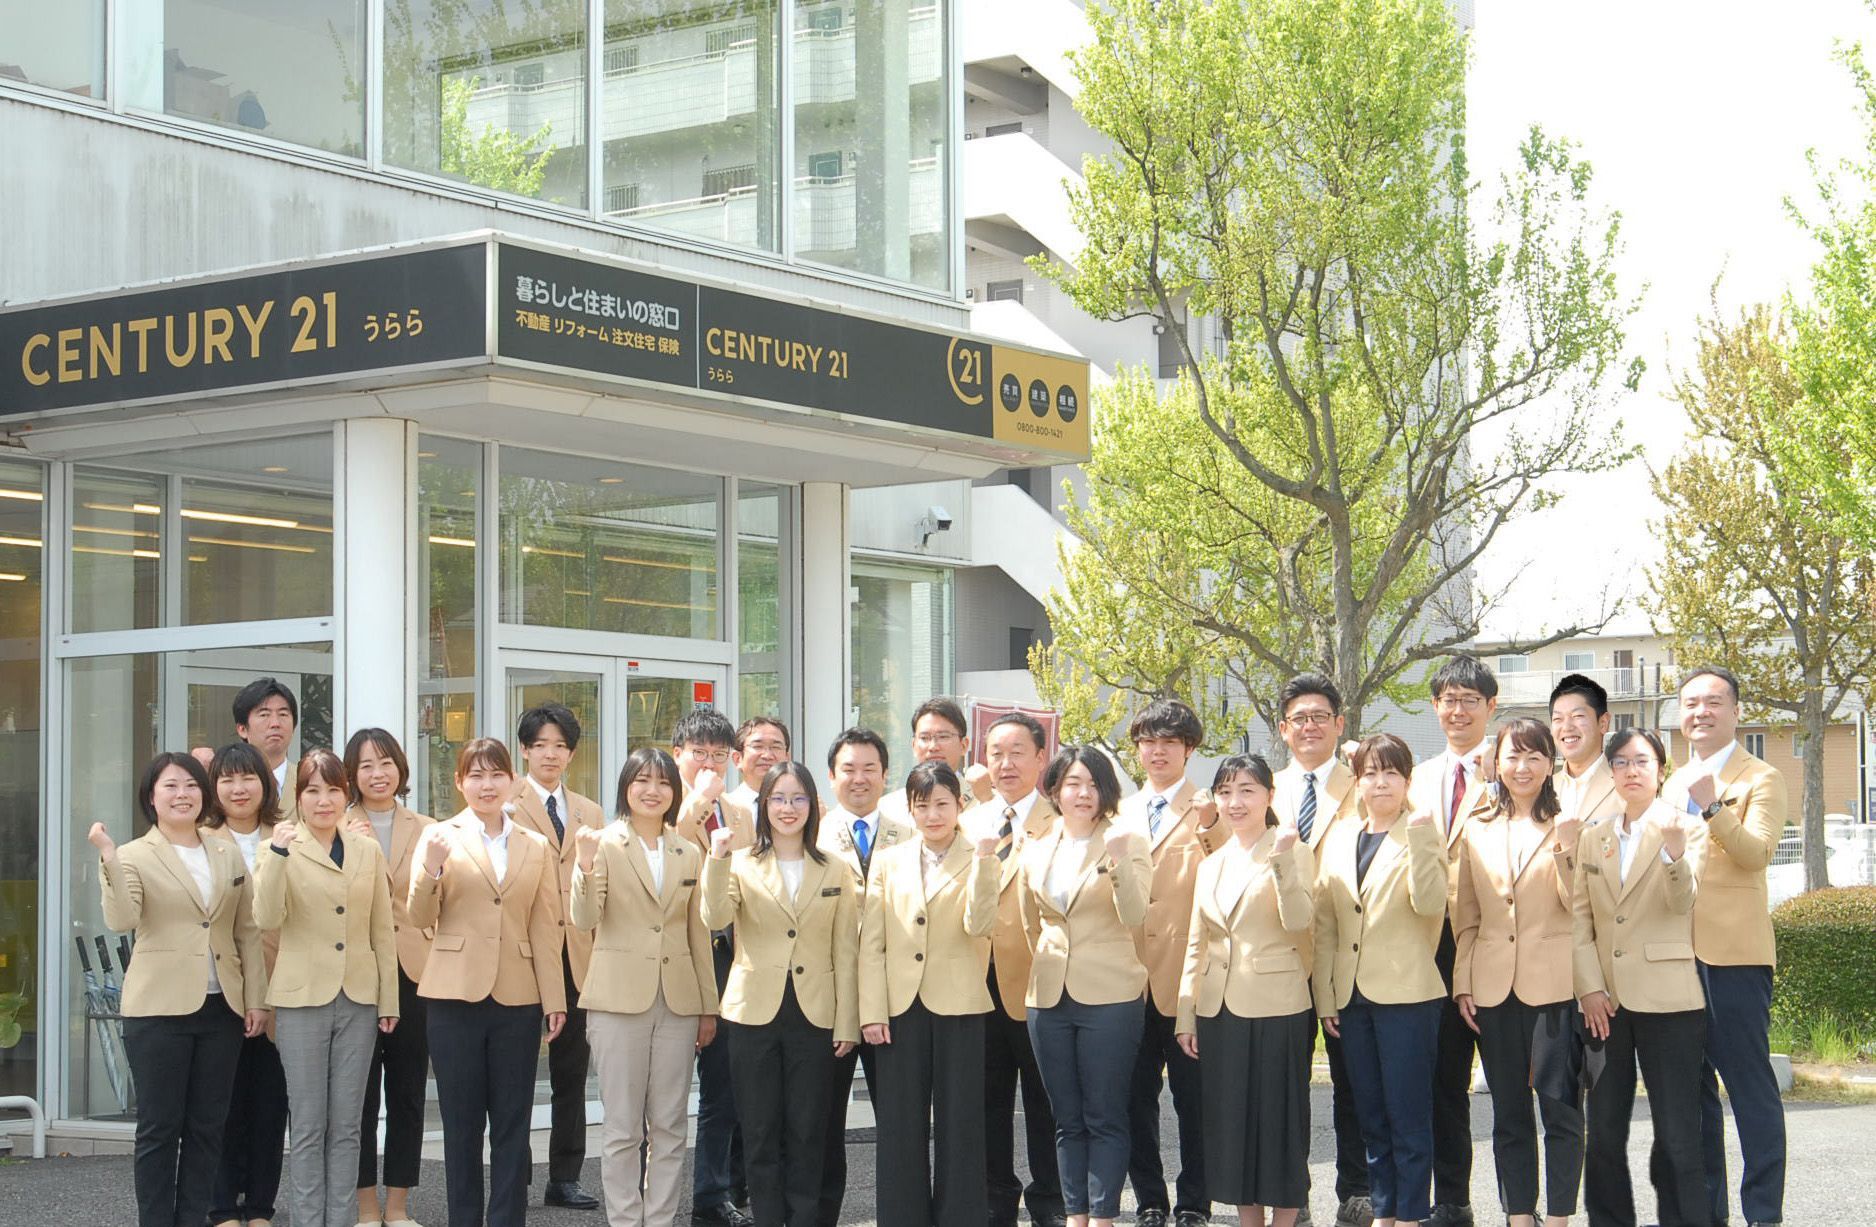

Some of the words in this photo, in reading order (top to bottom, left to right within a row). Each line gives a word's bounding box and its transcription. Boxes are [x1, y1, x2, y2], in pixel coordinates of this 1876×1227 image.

[363, 308, 424, 342] うらら
[516, 275, 680, 331] 暮らしと住まいの窓口
[21, 301, 275, 386] CENTURY
[290, 291, 337, 353] 21
[515, 309, 550, 333] 不動産
[554, 318, 609, 343] リフォーム
[612, 327, 656, 351] 注文住宅
[658, 337, 680, 356] 保険
[706, 327, 824, 373] CENTURY
[828, 350, 849, 379] 21
[708, 367, 734, 384] うらら
